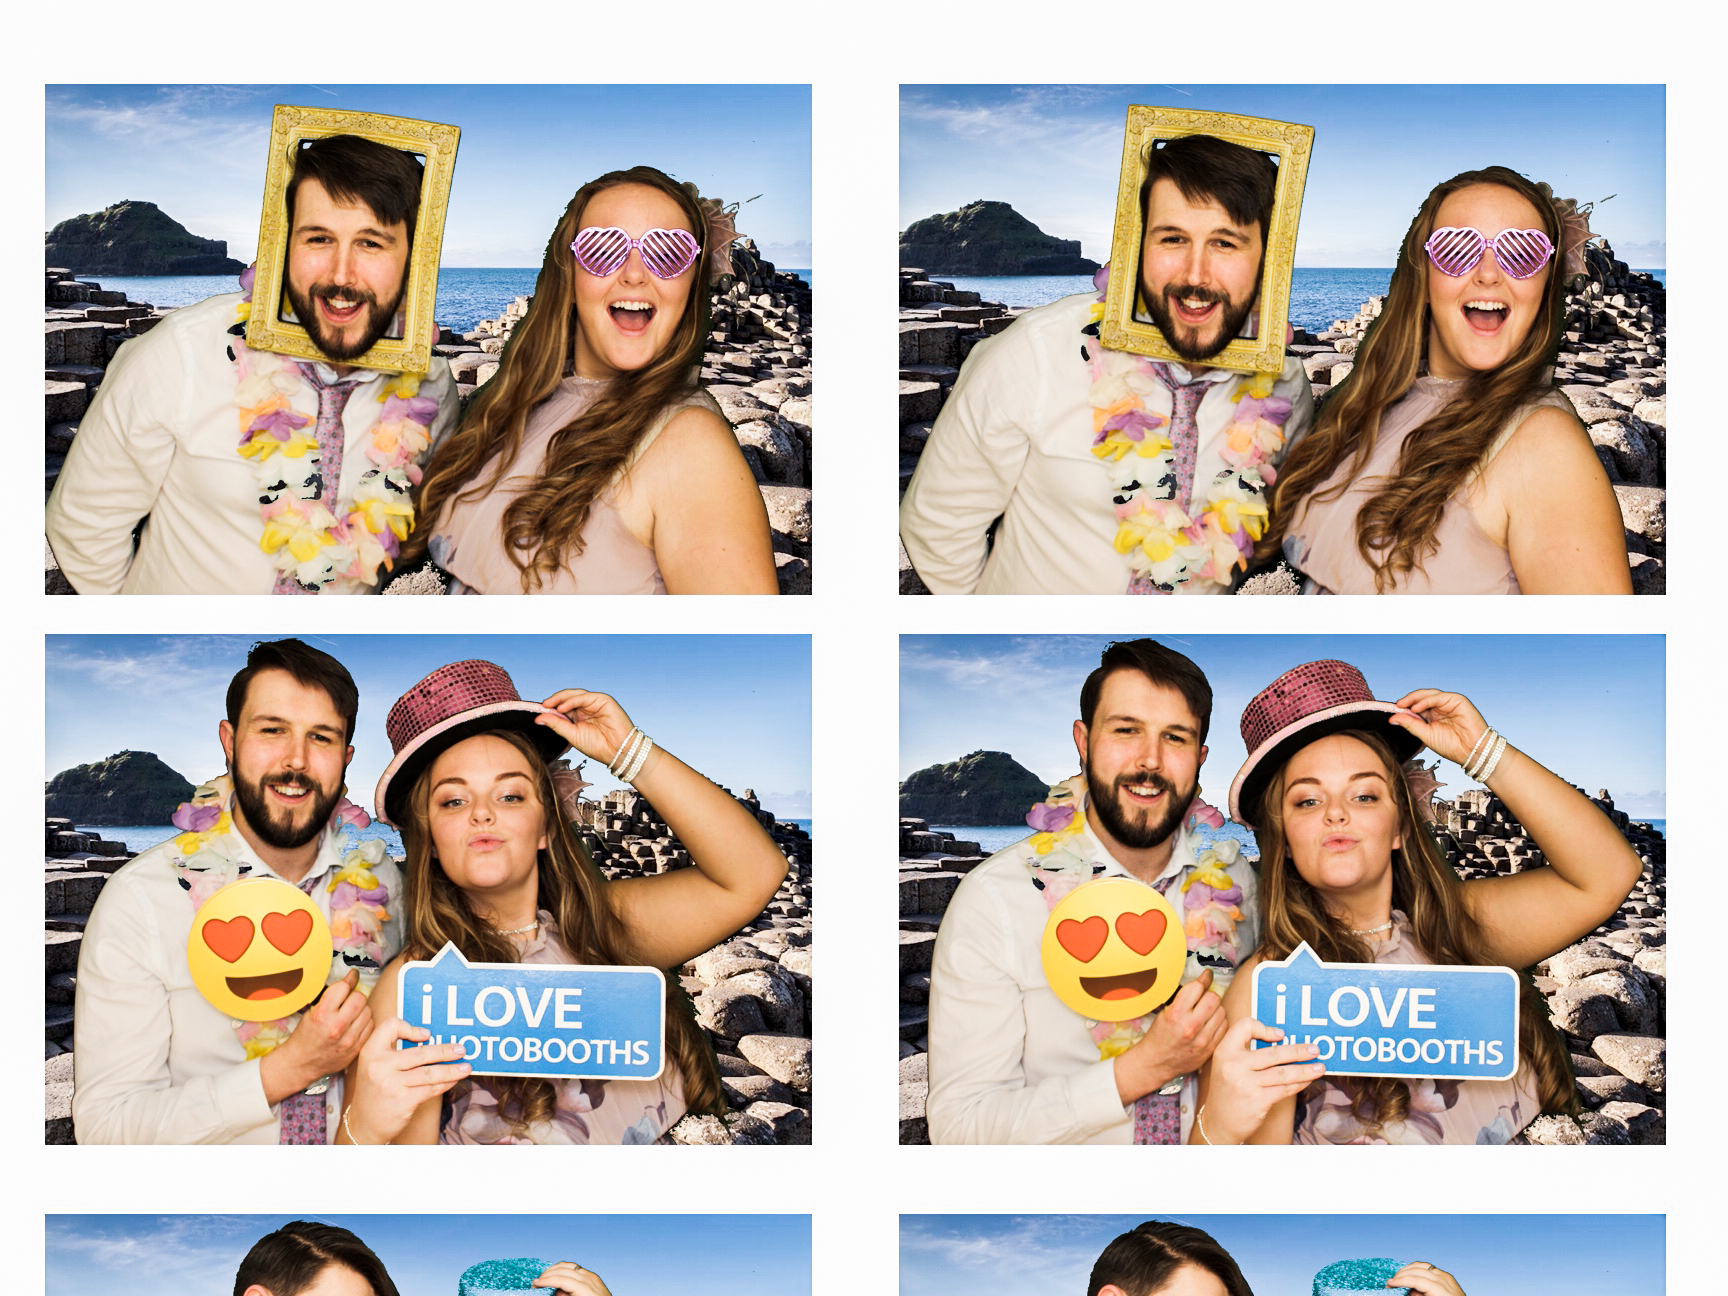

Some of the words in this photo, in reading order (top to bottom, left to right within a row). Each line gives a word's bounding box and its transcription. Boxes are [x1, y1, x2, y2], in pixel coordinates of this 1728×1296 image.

[421, 983, 433, 1025] i
[447, 984, 583, 1029] LOVE
[1275, 983, 1287, 1025] i
[1301, 984, 1437, 1029] LOVE
